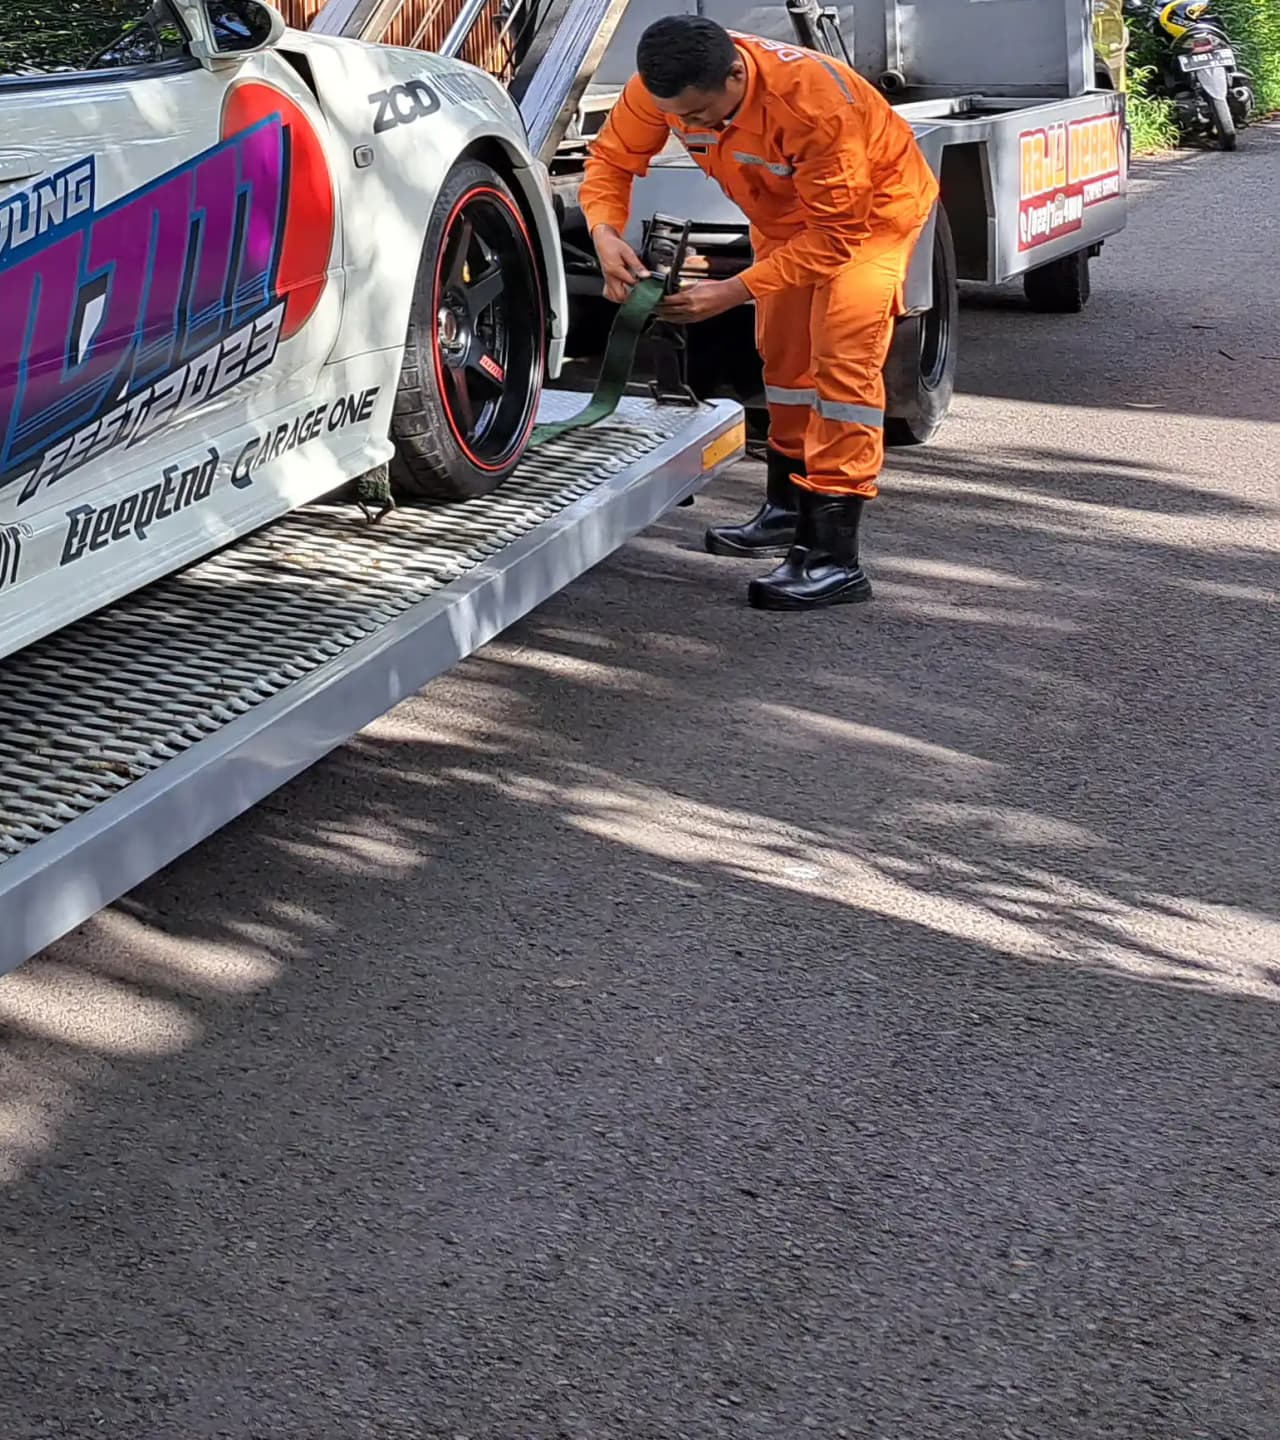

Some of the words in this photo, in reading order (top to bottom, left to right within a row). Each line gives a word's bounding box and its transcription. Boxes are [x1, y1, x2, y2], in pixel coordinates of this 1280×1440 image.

[367, 79, 441, 135] ZCD
[230, 403, 324, 490] GARAGE
[326, 385, 382, 433] ONE
